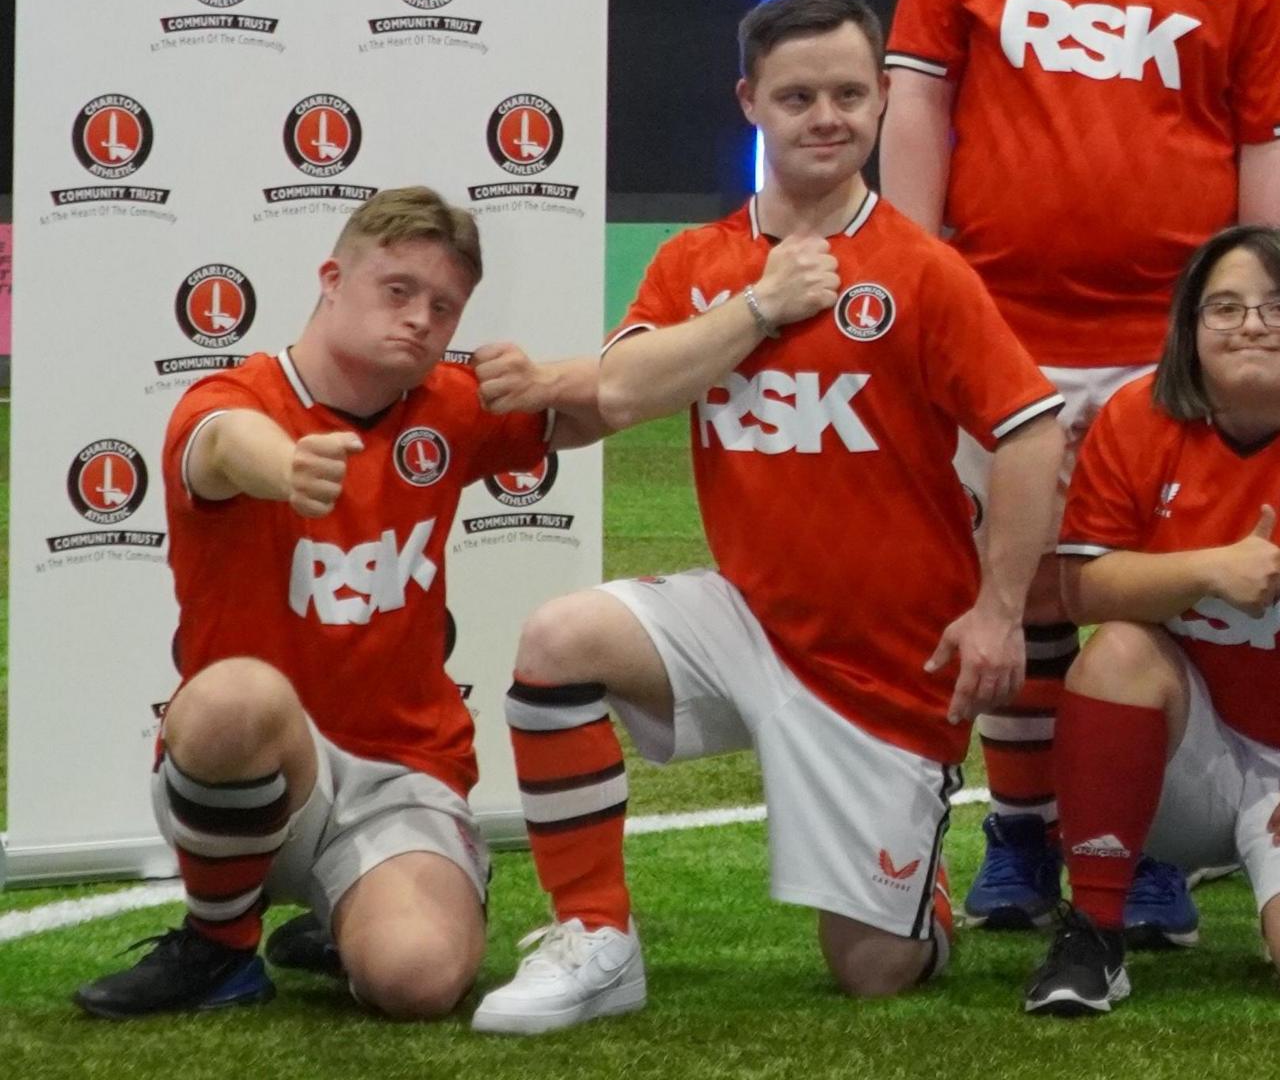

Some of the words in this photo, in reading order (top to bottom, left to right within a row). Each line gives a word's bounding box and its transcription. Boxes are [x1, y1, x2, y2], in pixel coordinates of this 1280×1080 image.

[168, 16, 234, 30] COMMUNITY
[237, 16, 273, 31] TRUST
[375, 18, 440, 32] COMMUNITY
[443, 18, 477, 33] TRUST
[84, 96, 142, 116] CHARLTON
[295, 96, 350, 116] CHARLTON
[498, 96, 553, 115] CHARLTON
[89, 162, 137, 179] ATHLETIC
[300, 161, 345, 176] ATHLETIC
[502, 160, 548, 175] ATHLETIC
[58, 188, 126, 204] COMMUNITY
[129, 188, 164, 202] TRUST
[270, 186, 336, 201] COMMUNITY
[338, 186, 373, 200] TRUST
[474, 184, 537, 198] COMMUNITY
[541, 184, 573, 198] TRUST
[187, 265, 245, 286] CHARLTON
[849, 285, 887, 299] CHARLTON
[192, 331, 240, 347] ATHLETIC
[162, 356, 229, 372] COMMUNITY
[444, 351, 472, 365] RUST
[698, 370, 880, 455] RSK
[79, 440, 137, 461] CHARLTON
[497, 491, 542, 507] ATHLETIC
[84, 506, 132, 524] ATHLETIC
[469, 515, 532, 531] COMMUNITY
[536, 515, 569, 529] TRUST
[54, 532, 121, 550] COMMUNITY
[124, 532, 160, 546] TRUST
[289, 517, 438, 626] RSK
